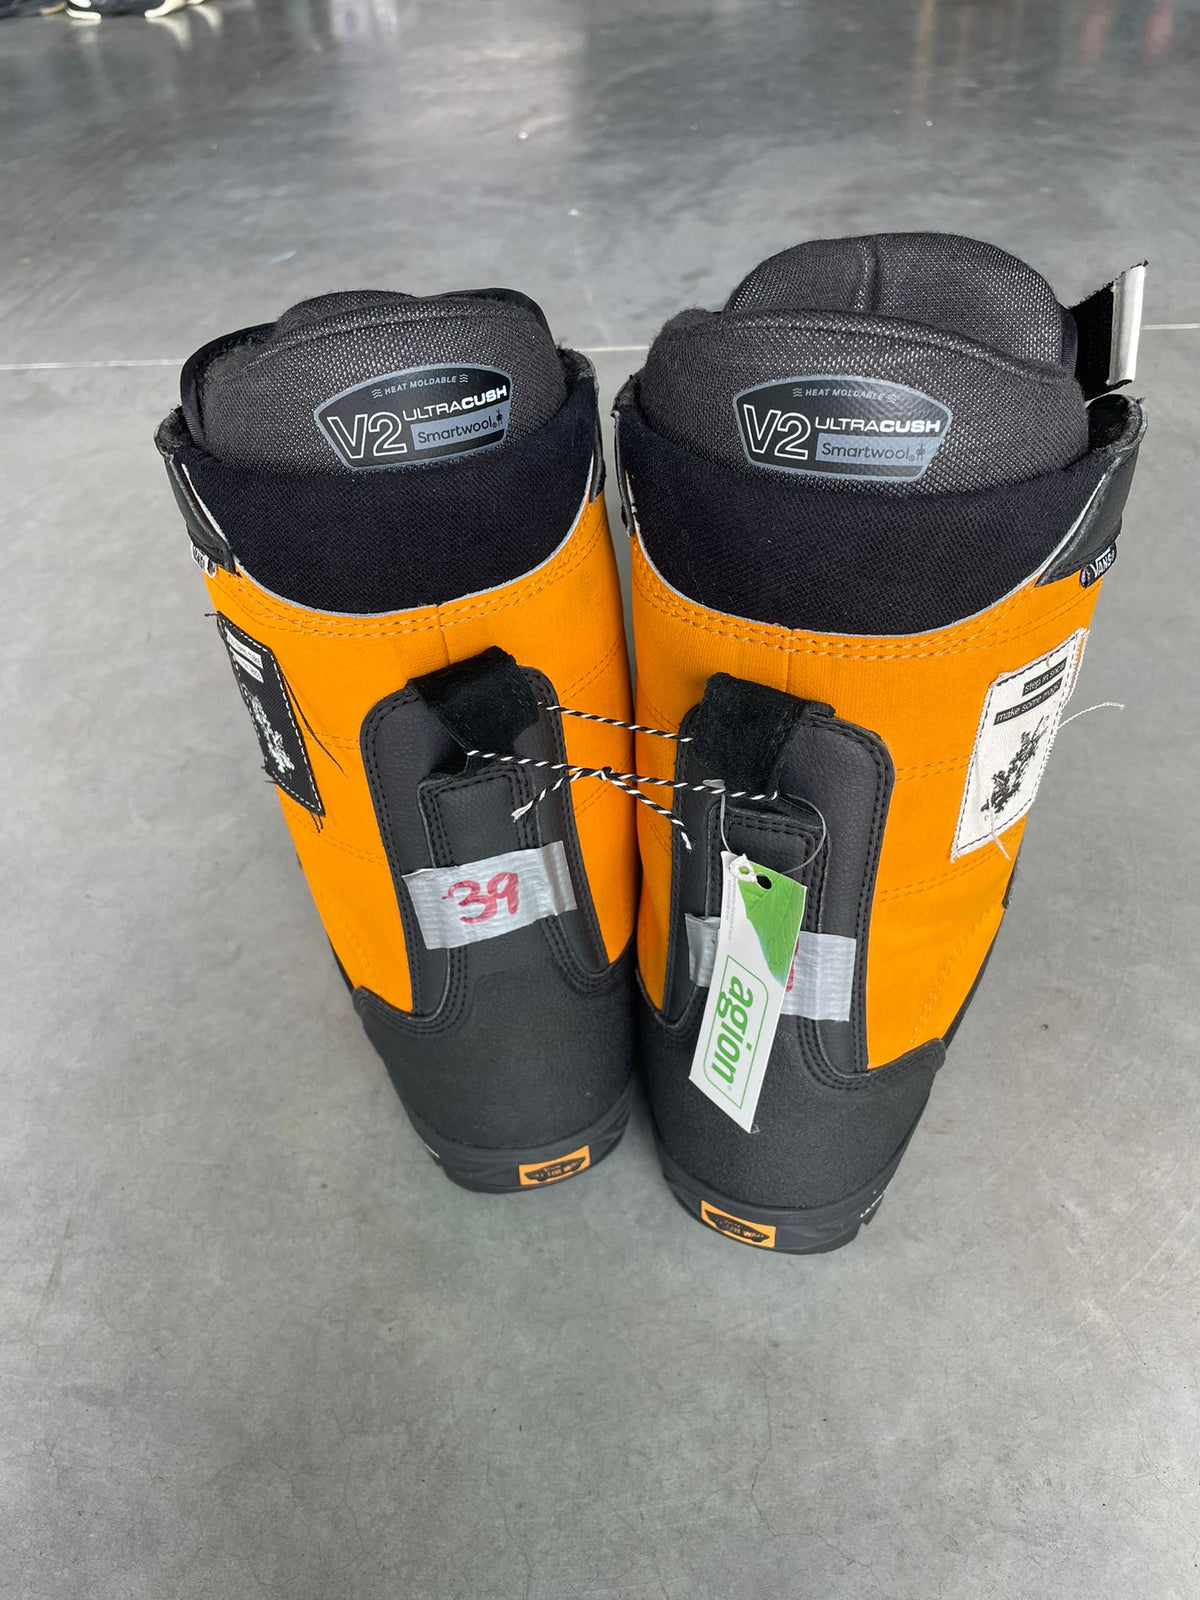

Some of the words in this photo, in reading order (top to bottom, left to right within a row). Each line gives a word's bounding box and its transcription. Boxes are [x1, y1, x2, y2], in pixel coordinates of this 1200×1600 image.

[384, 382, 408, 396] HEAT
[409, 376, 457, 389] MOLDABLE
[804, 388, 831, 398] HEAT
[831, 388, 886, 402] MOLDABLE
[327, 411, 408, 460] V2
[403, 385, 508, 421] ULTRACUSH
[416, 415, 493, 444] Smartwool
[743, 403, 811, 461] V2
[814, 415, 942, 433] ULTRACUSH
[821, 441, 910, 462] Smartwool
[441, 871, 520, 924] 39
[710, 974, 755, 1085] agion
